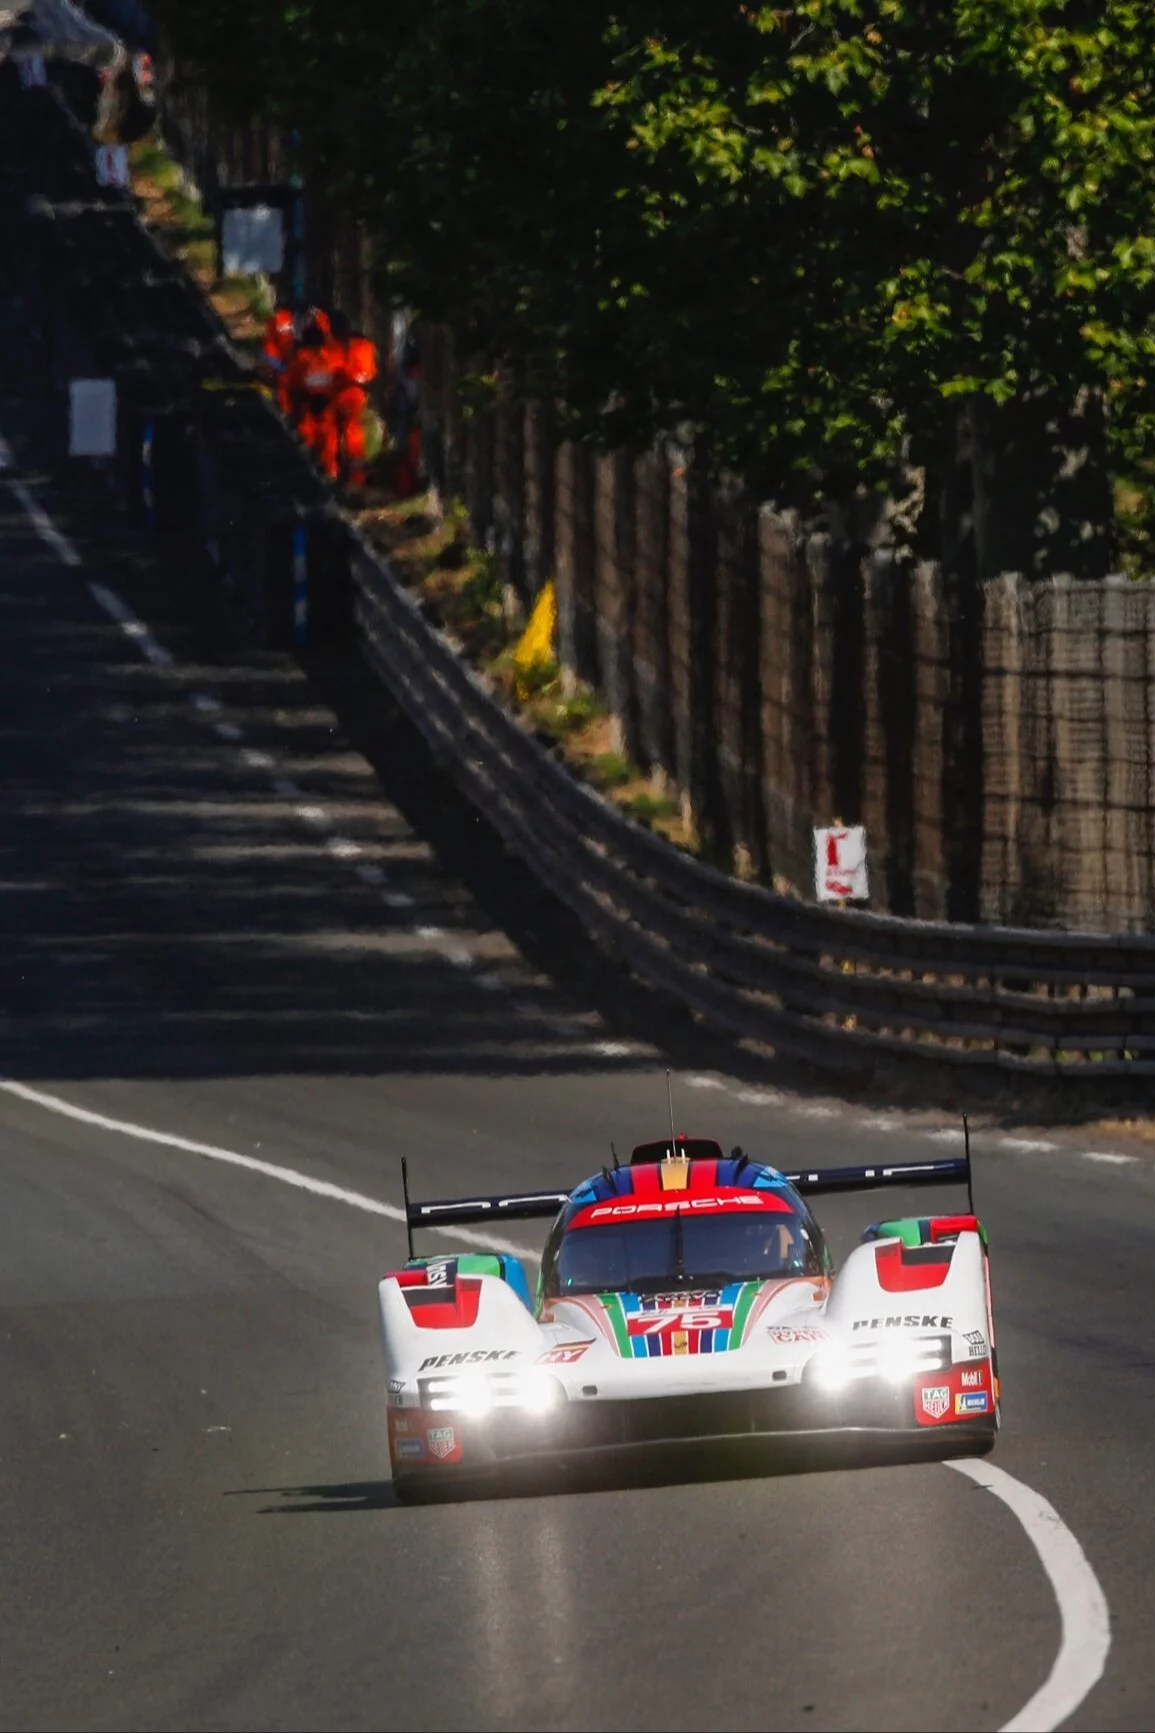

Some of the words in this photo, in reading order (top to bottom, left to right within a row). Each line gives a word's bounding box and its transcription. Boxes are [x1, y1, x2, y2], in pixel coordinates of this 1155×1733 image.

[590, 1195, 764, 1218] PORSCHE
[637, 1311, 722, 1334] 75
[852, 1315, 954, 1331] PENSKE
[924, 1390, 947, 1400] TAG
